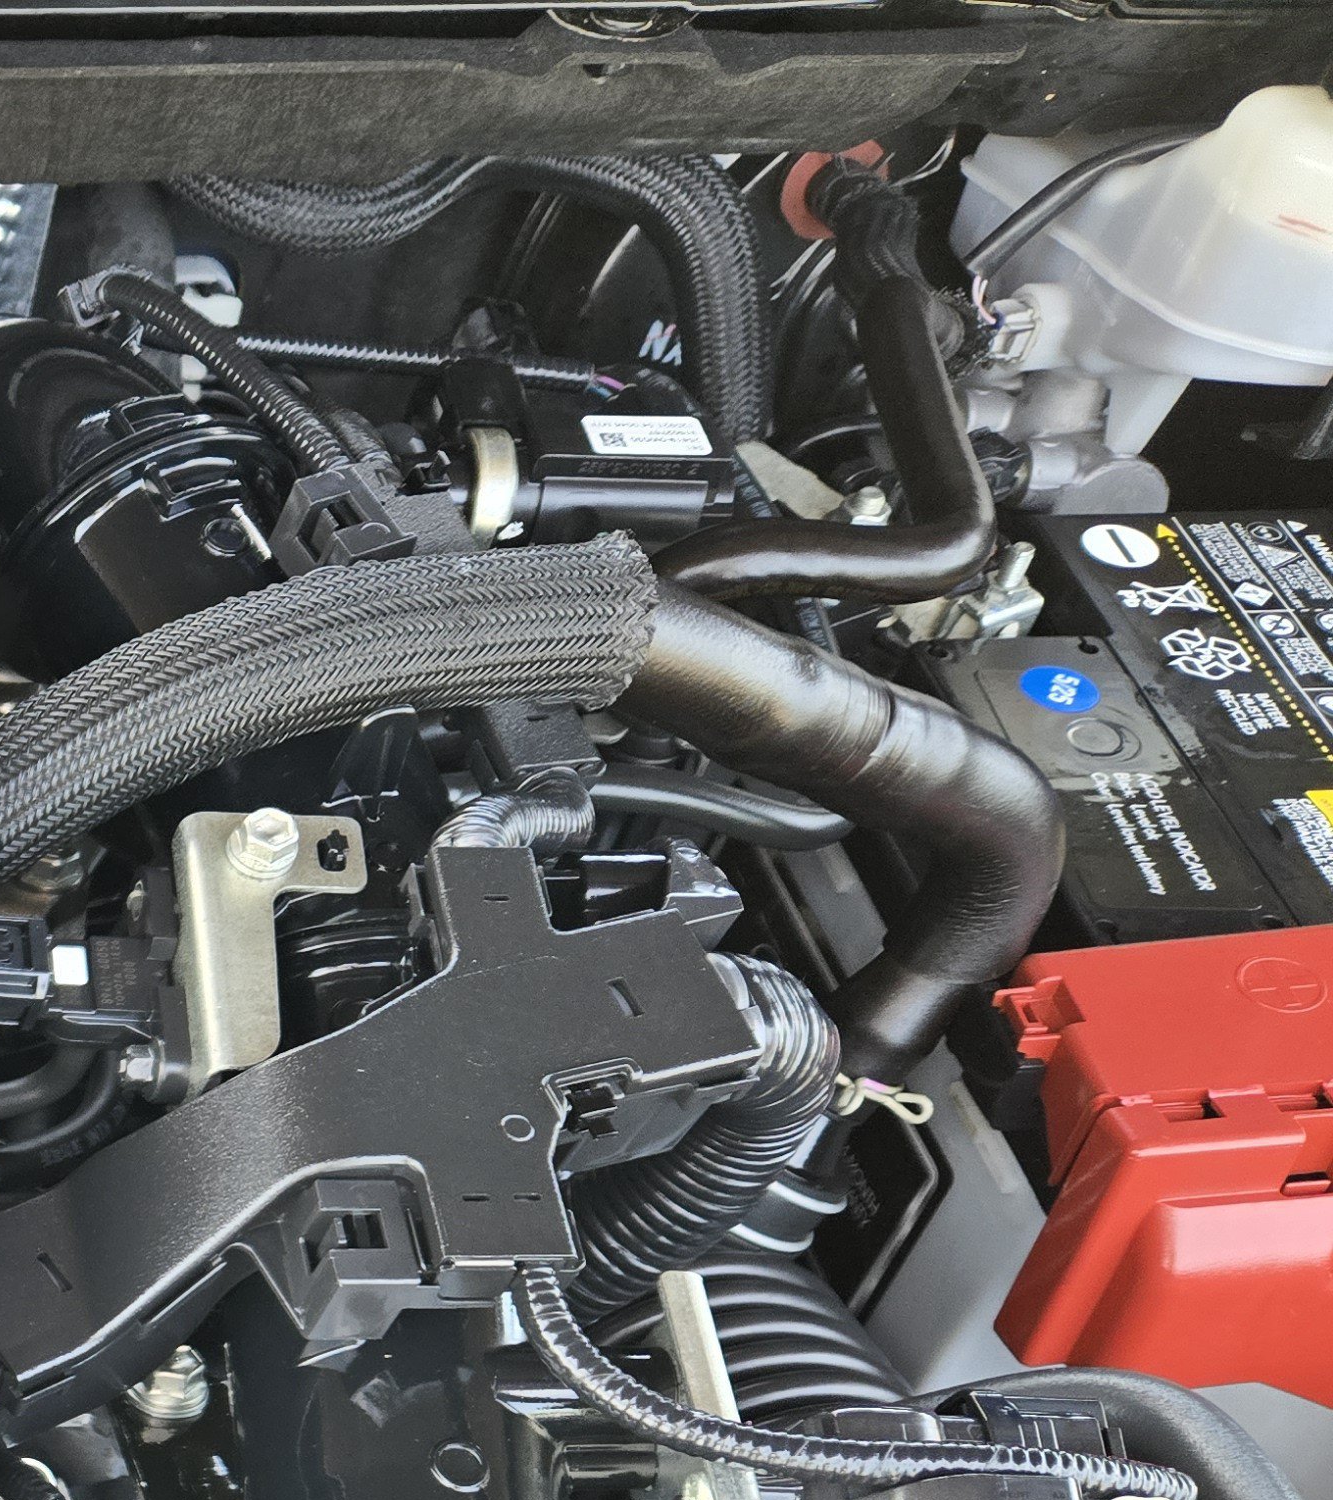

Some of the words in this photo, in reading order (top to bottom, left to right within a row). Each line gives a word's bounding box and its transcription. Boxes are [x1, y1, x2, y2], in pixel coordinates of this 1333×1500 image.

[1214, 688, 1259, 736] RECYCLED
[1236, 692, 1264, 721] MUST
[1253, 692, 1292, 729] BATTERY
[1147, 799, 1182, 832] LEVEL
[1168, 830, 1218, 892] INDICATOR
